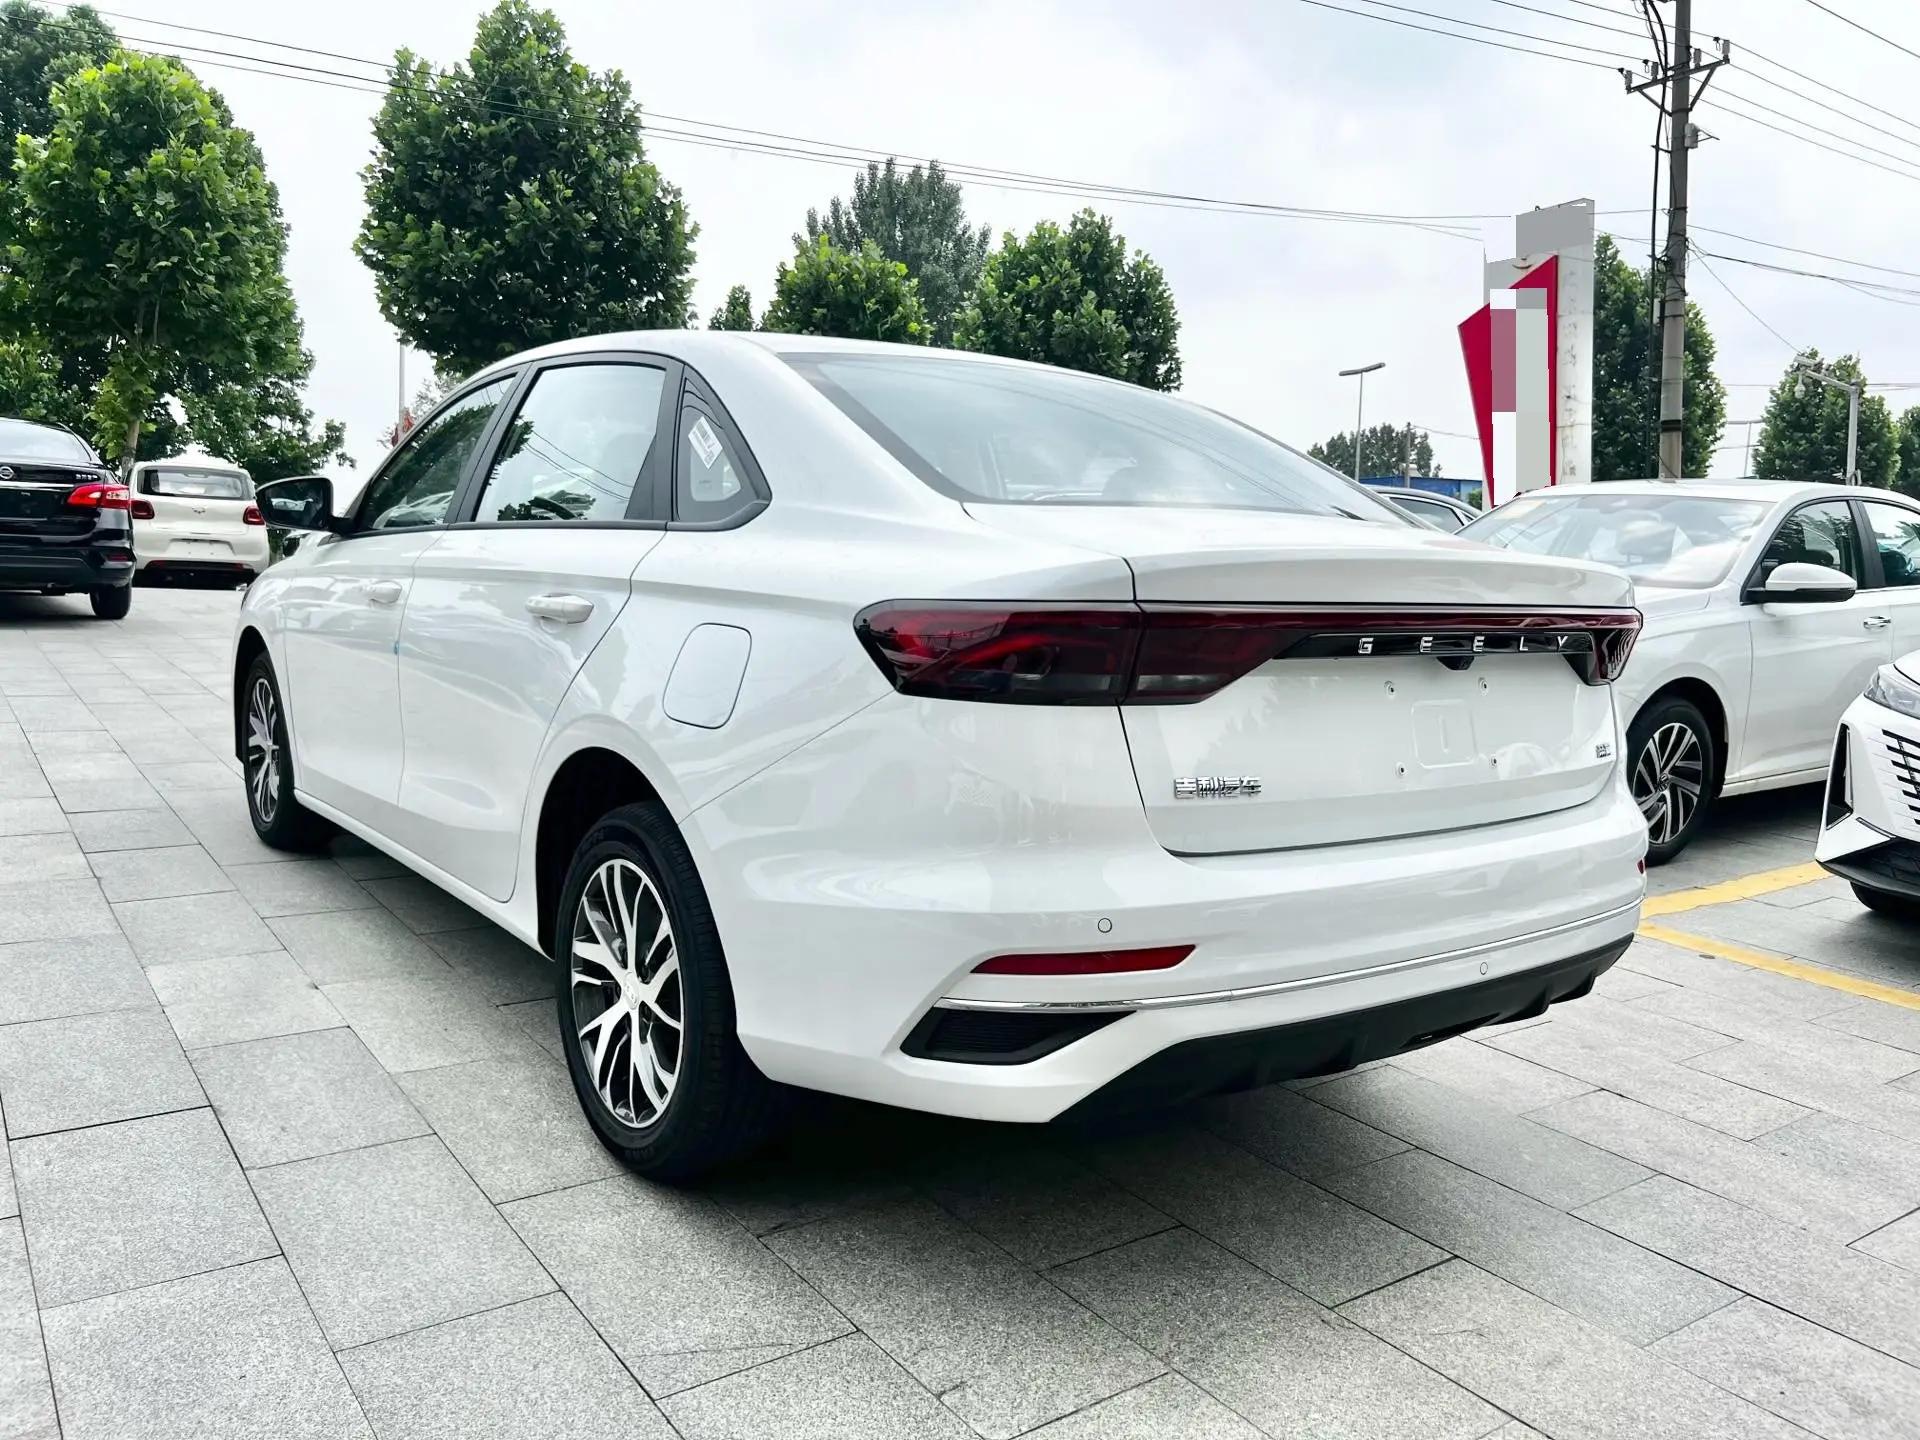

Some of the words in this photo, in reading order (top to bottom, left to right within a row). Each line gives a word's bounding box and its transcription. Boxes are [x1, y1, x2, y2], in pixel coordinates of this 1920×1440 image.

[1357, 635, 1569, 655] GEELY
[1173, 776, 1262, 801] 吉利汽车
